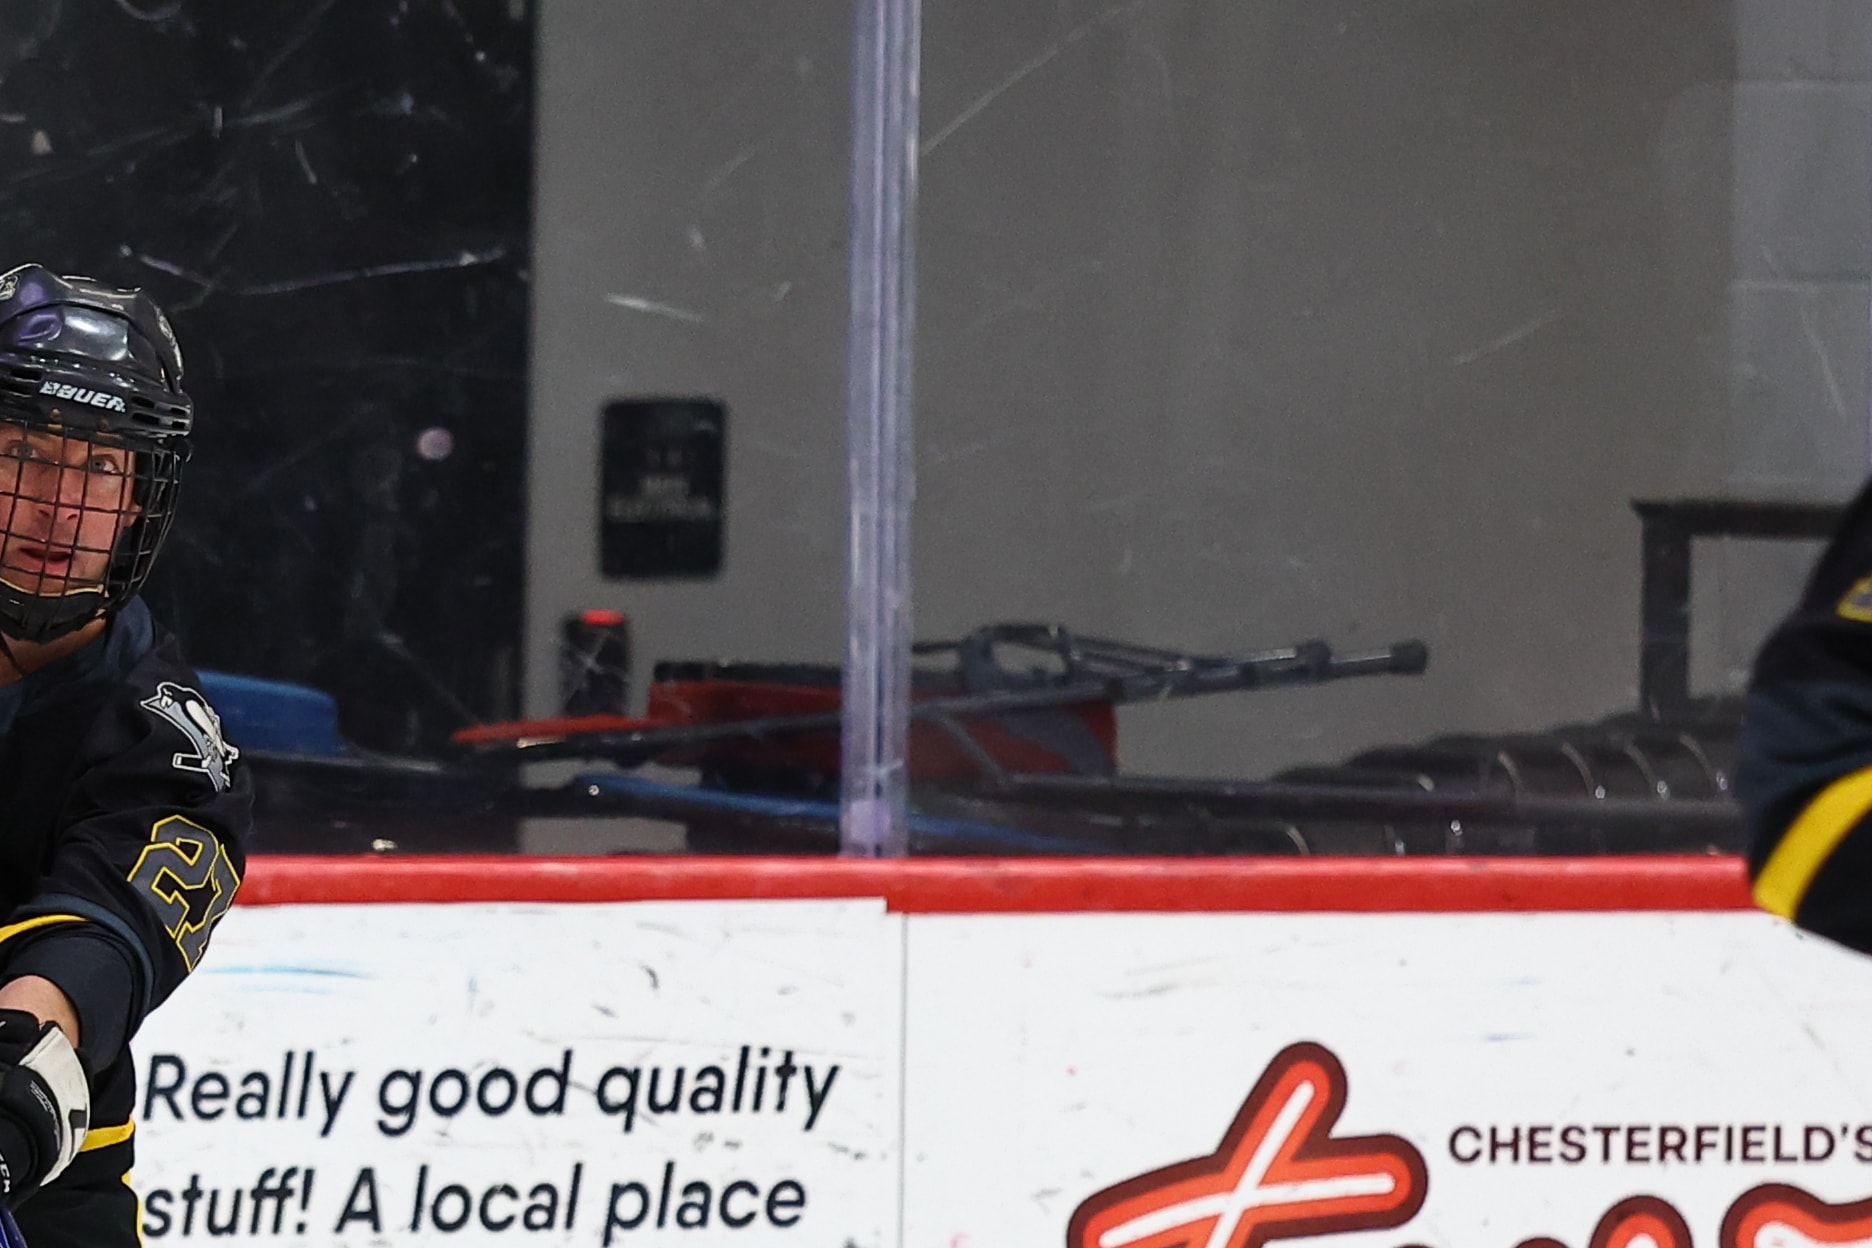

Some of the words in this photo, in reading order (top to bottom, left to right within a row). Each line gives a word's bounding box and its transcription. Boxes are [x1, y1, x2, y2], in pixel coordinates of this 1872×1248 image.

[39, 380, 126, 413] BAUER
[141, 1049, 356, 1138] Really
[376, 1048, 574, 1139] good
[592, 1044, 841, 1134] quality
[140, 1165, 316, 1239] stuff!
[333, 1166, 382, 1235] A
[409, 1161, 584, 1234] local
